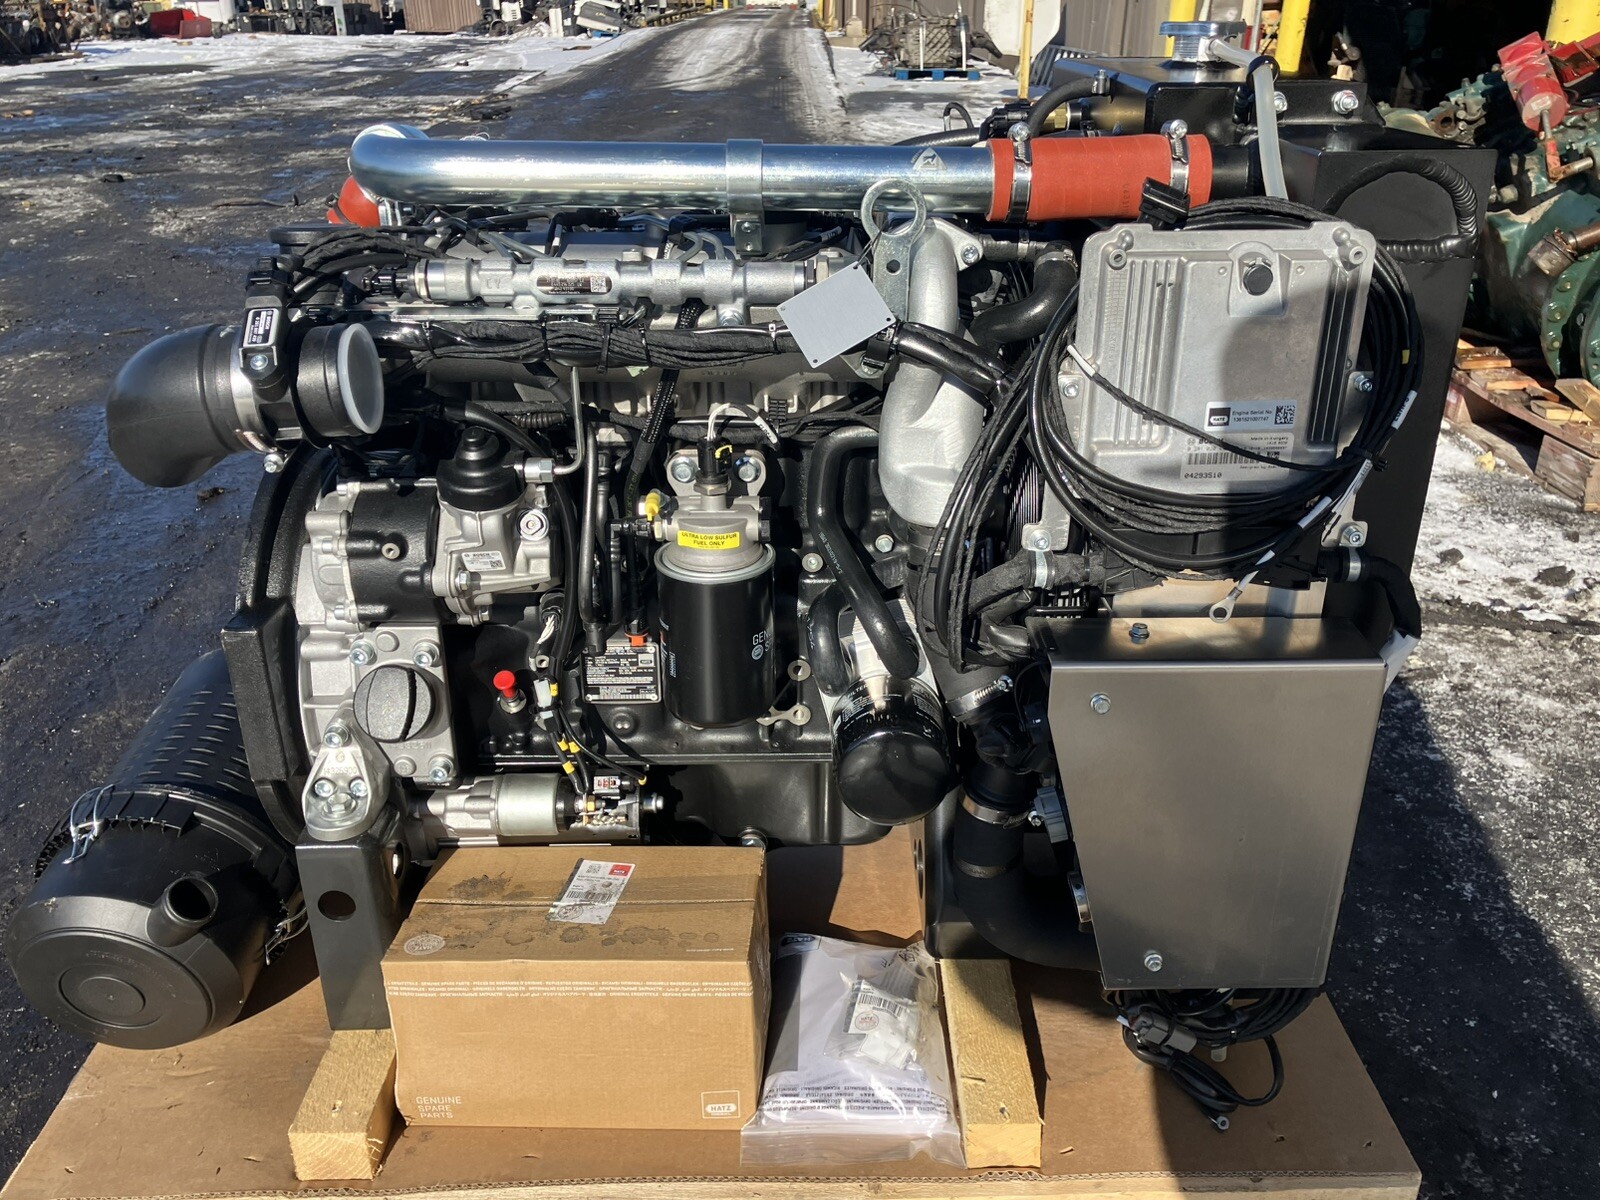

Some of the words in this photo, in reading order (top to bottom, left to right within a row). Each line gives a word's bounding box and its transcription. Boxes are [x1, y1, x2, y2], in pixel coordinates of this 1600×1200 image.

[681, 531, 699, 539] ULTRA
[416, 1096, 462, 1104] GENUINE
[418, 1104, 453, 1112] SPARE
